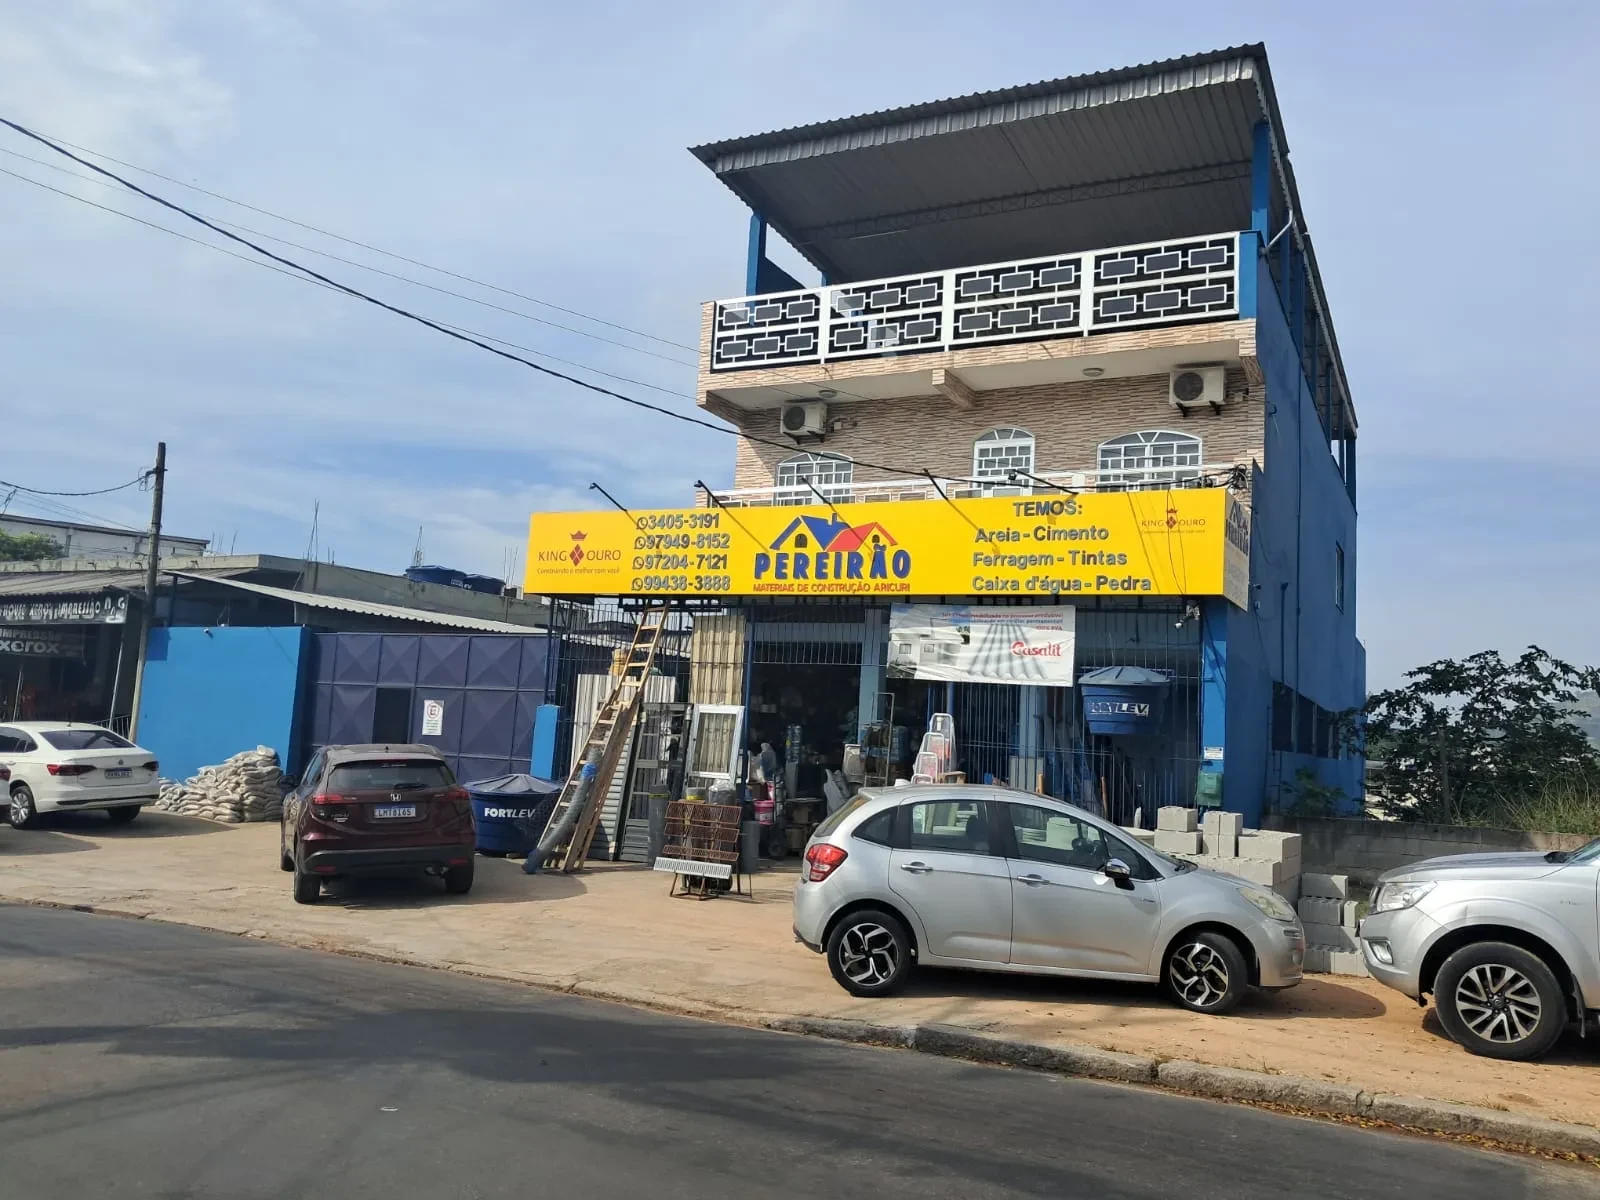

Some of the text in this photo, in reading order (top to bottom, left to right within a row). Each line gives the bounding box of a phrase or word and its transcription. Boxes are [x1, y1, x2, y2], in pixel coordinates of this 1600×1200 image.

[1013, 500, 1083, 516] TEMOS:
[648, 513, 719, 529] 3405-3191
[1142, 519, 1164, 527] KING
[646, 533, 730, 549] 97949-8152
[975, 528, 1020, 542] Areia
[1034, 525, 1109, 541] Cimento
[538, 549, 621, 561] KING OURO
[645, 554, 728, 570] 97204-7121
[754, 544, 911, 580] PEREIRÃO
[973, 552, 1054, 569] Ferragem
[1068, 550, 1127, 565] Tintas
[643, 575, 731, 591] 99438-3888
[753, 581, 910, 594] MATERIAIS DE CONSTRUÇÃO ARICURI
[972, 576, 1020, 591] Caixa
[1096, 575, 1152, 590] Pedra
[1011, 641, 1061, 657] Casalit
[484, 807, 536, 818] FORTLEV
